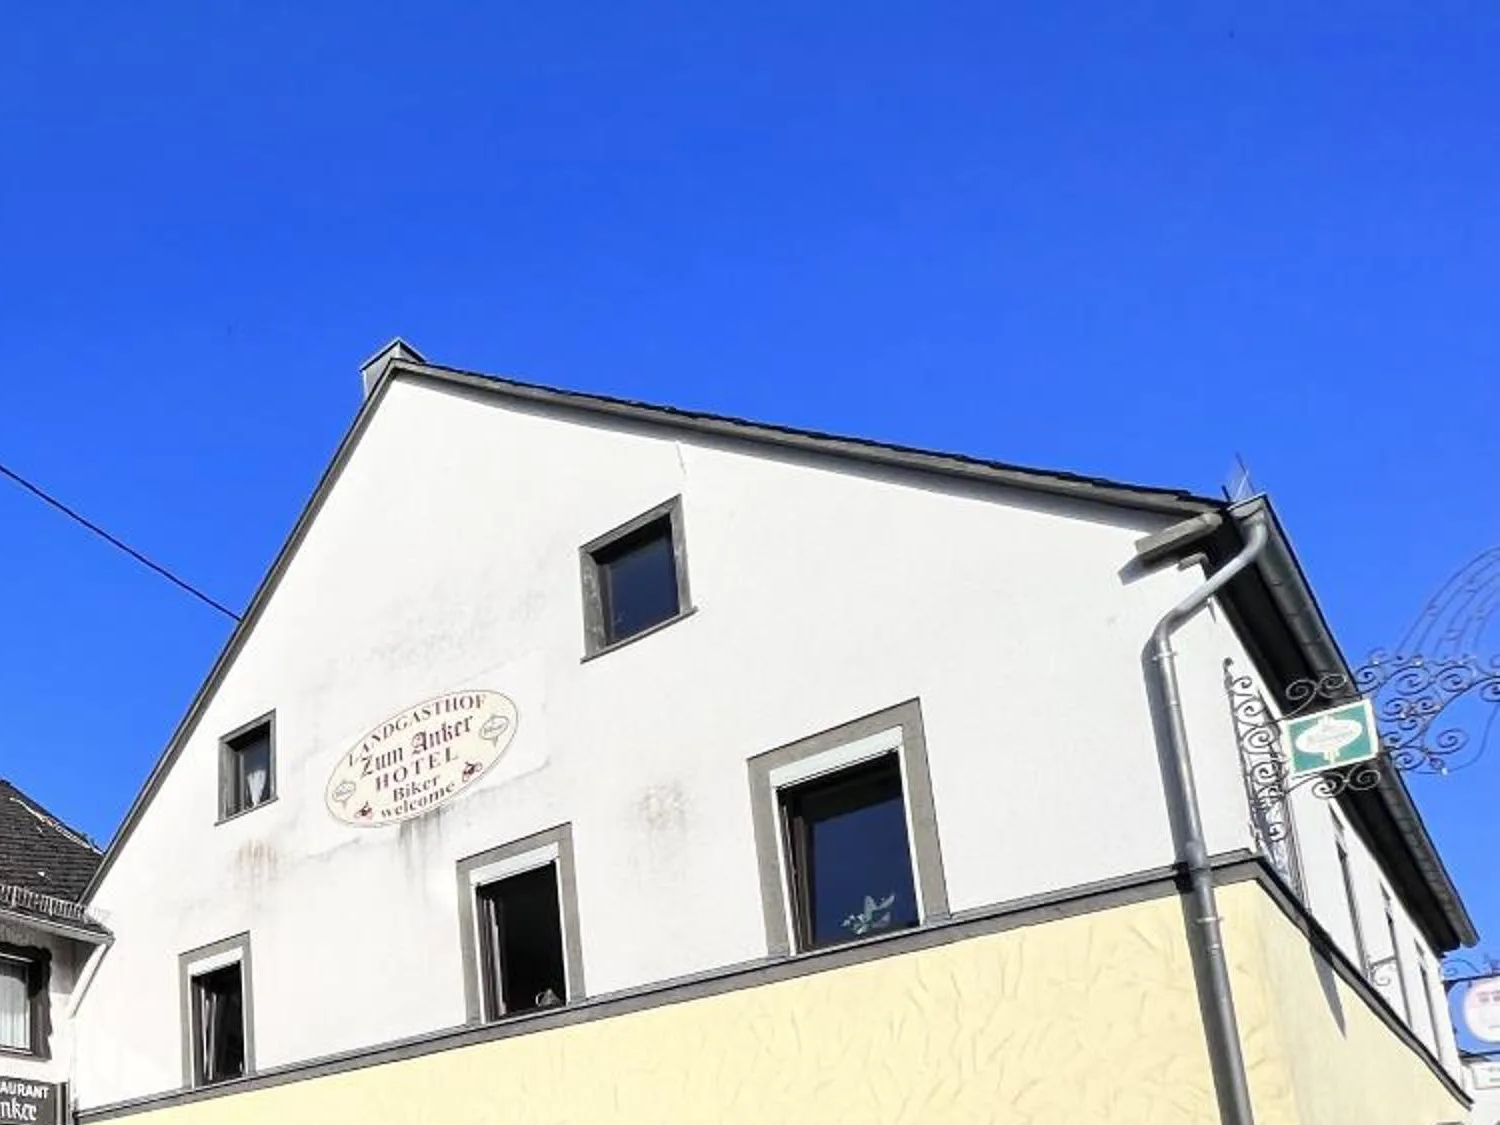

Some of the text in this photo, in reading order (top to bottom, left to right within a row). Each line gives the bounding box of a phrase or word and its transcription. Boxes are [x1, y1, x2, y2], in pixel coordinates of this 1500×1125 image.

[349, 693, 486, 767] LANDGASTHOF
[361, 747, 403, 779] Zum
[411, 715, 474, 755] Anker
[375, 747, 458, 791] HOTEL
[393, 775, 440, 802] Biker
[381, 783, 455, 817] welcome
